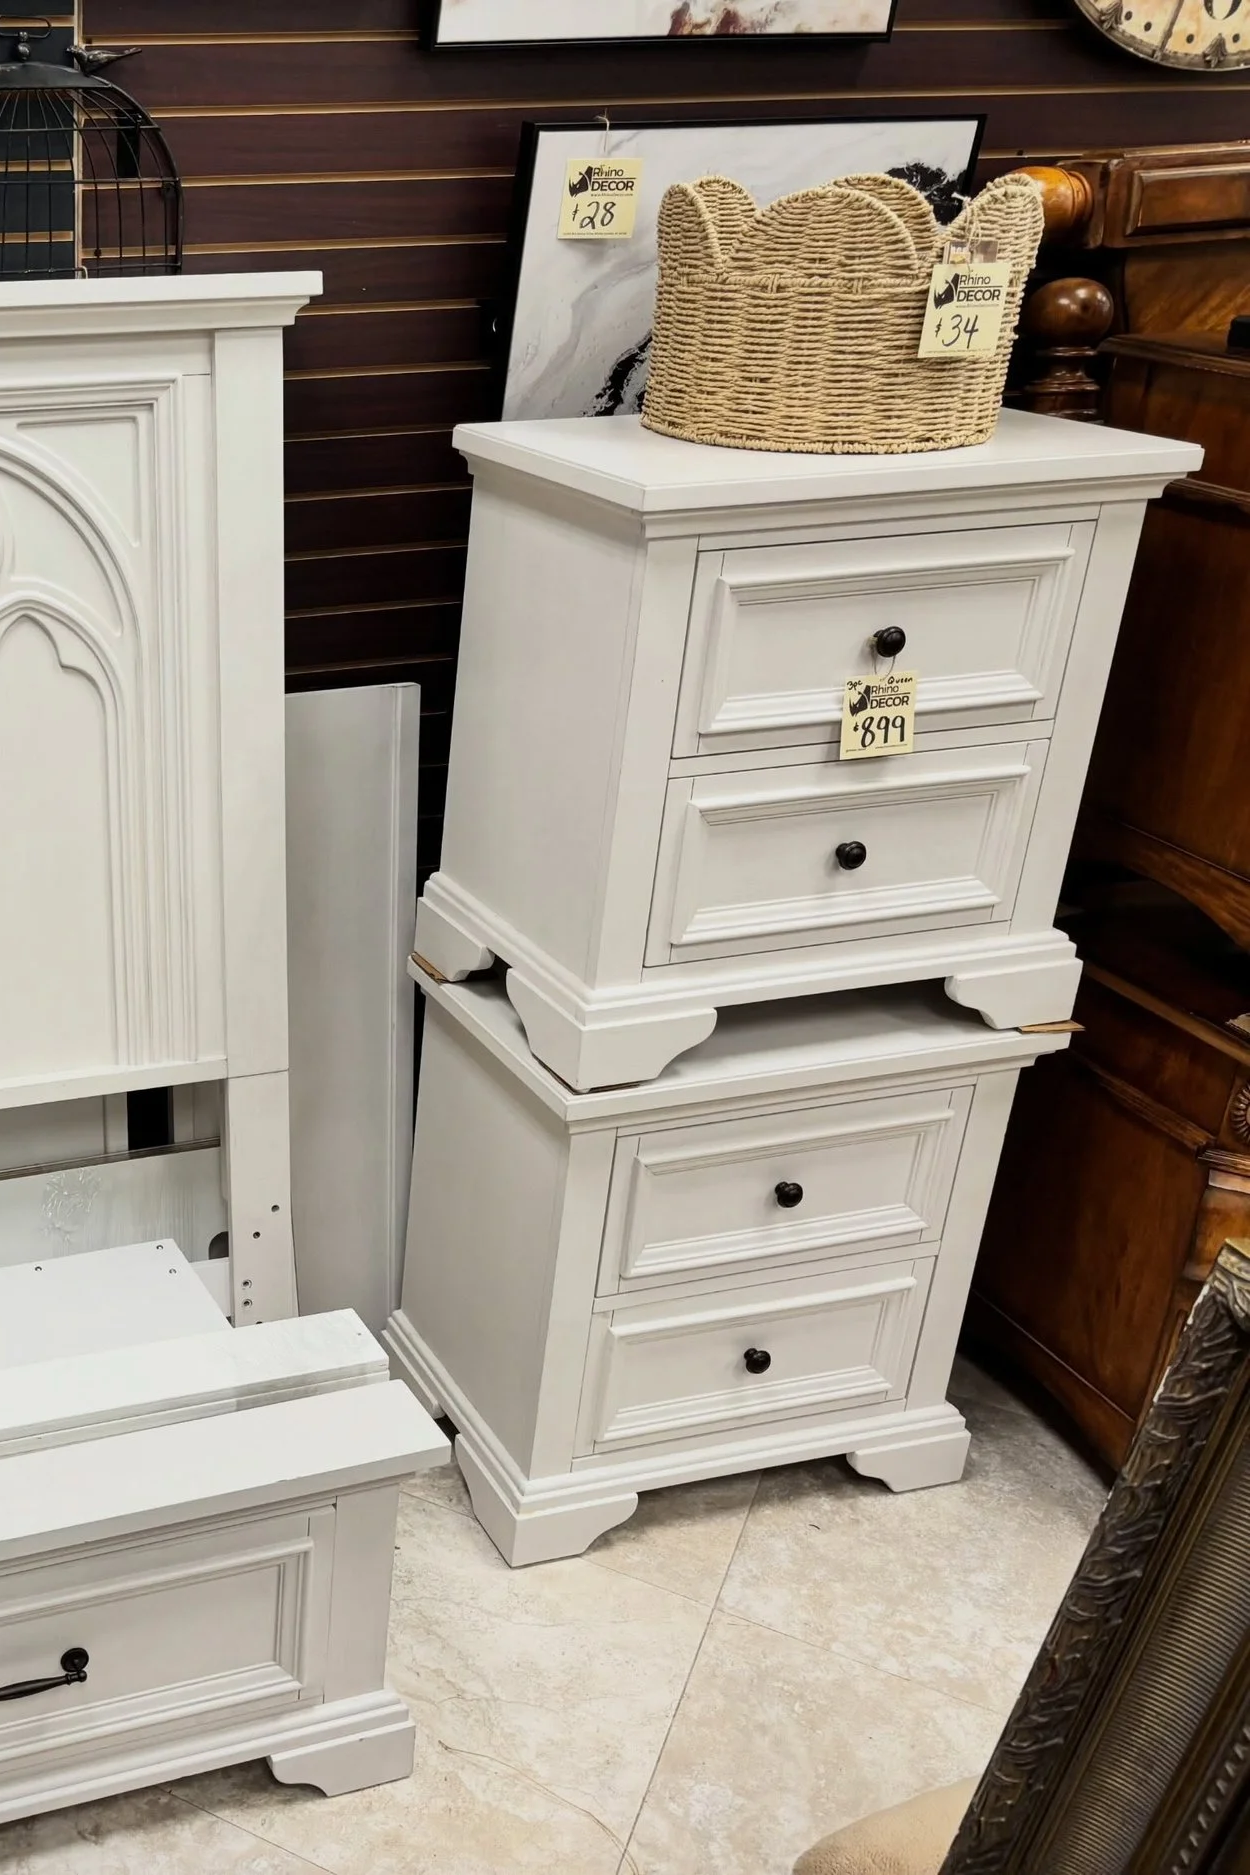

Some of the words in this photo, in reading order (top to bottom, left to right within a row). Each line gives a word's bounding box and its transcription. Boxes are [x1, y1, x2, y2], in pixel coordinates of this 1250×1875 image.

[593, 165, 624, 177] Rhino
[591, 180, 635, 191] DECOR
[959, 274, 991, 285] Rhino
[956, 289, 1001, 302] DECOR
[871, 684, 899, 695] Rhino
[870, 695, 909, 709] DECOR
